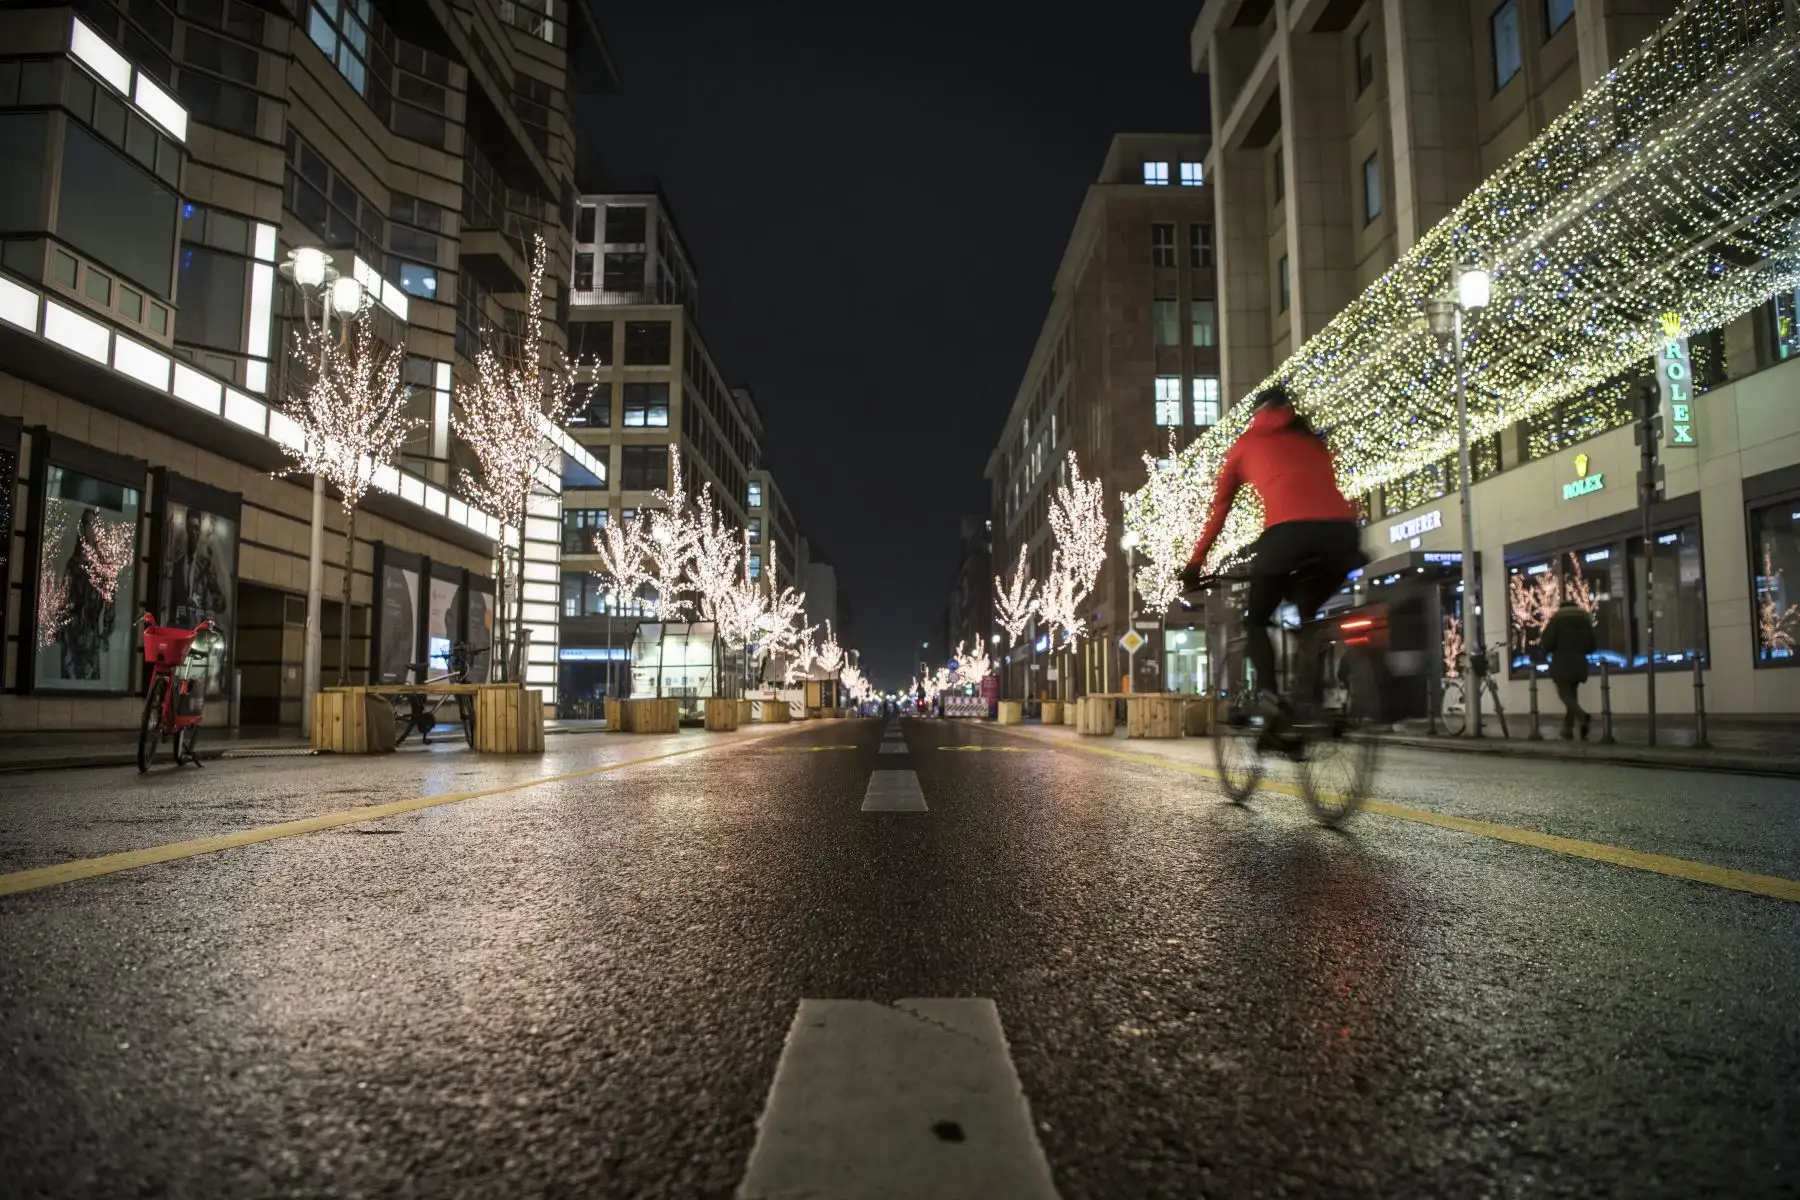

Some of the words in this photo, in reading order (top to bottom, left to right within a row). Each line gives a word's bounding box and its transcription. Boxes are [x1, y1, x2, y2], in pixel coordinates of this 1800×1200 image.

[1665, 342, 1693, 443] ROLEX
[1563, 474, 1604, 500] ROLEX
[1389, 511, 1441, 543] BUCHERER
[1424, 553, 1463, 562] BUCHERE
